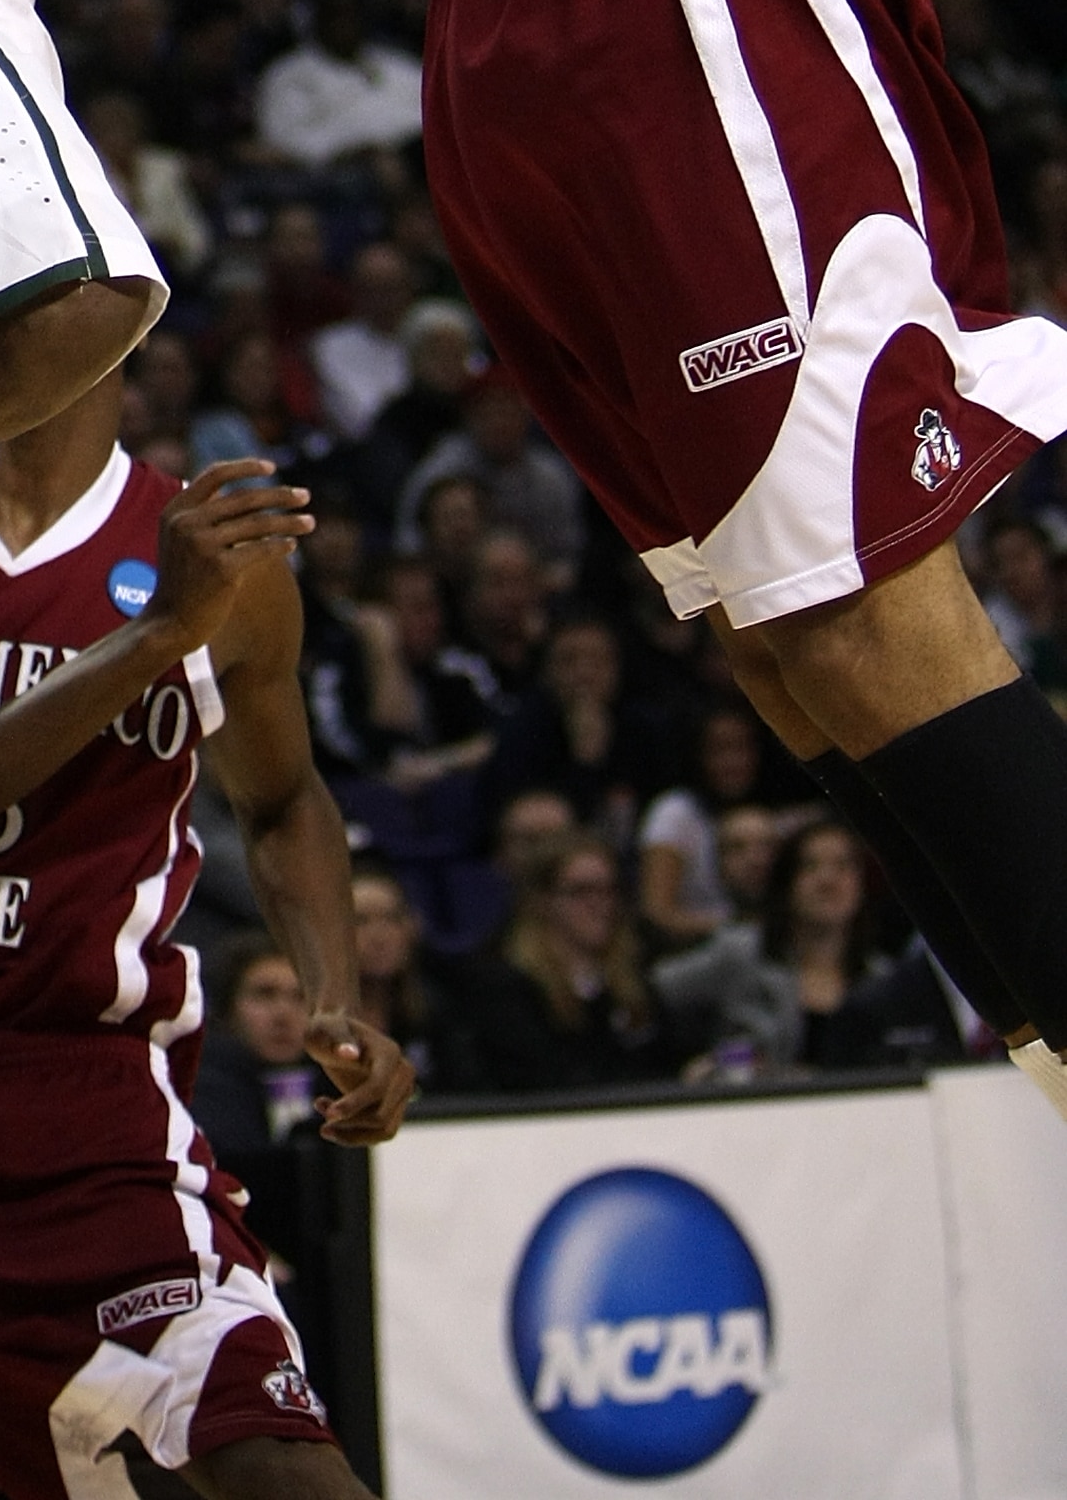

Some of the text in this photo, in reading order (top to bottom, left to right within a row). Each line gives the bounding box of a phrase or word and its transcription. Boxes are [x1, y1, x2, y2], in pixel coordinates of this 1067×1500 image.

[687, 323, 790, 384] WAC
[115, 584, 153, 605] NCA
[102, 1282, 194, 1326] WAC
[537, 1308, 772, 1412] NCAA
